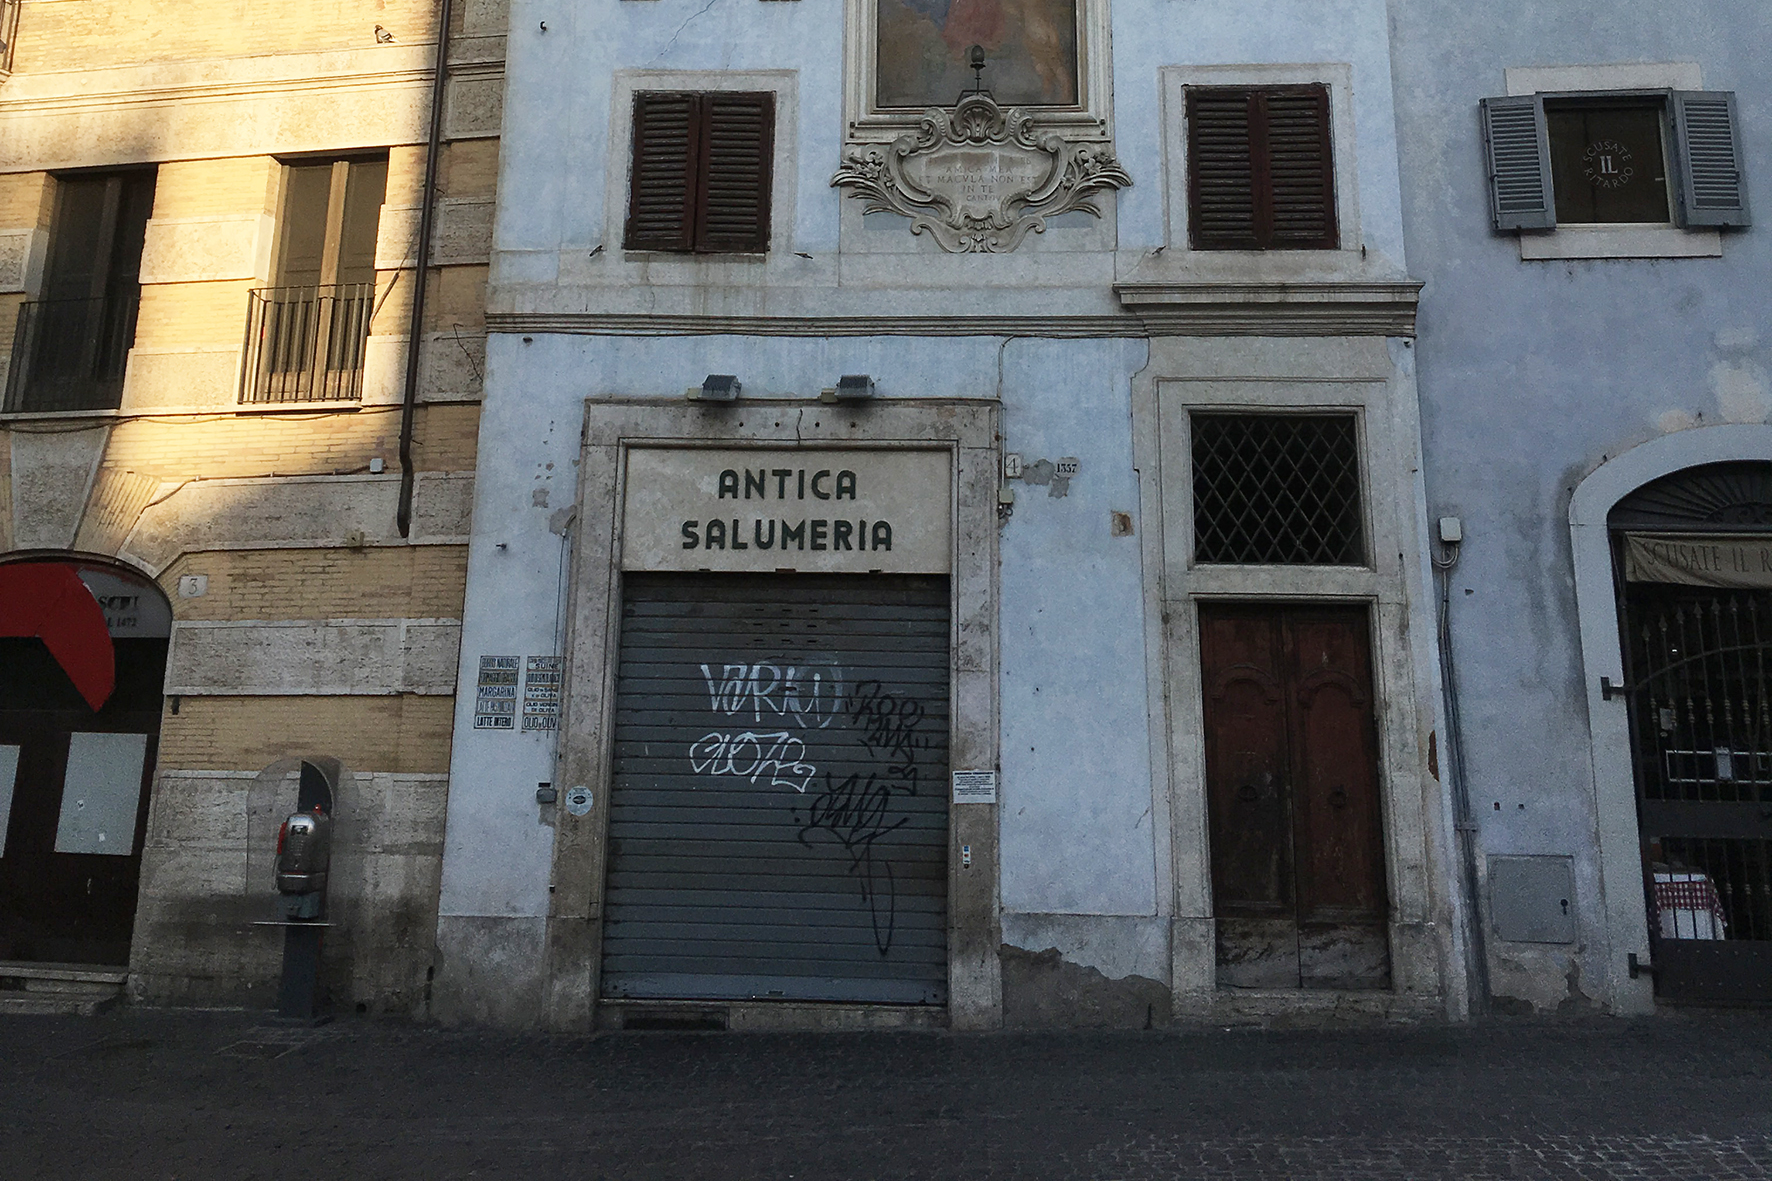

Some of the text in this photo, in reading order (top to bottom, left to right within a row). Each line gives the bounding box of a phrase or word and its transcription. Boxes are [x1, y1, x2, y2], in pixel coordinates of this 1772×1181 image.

[1583, 141, 1632, 162] SCUSATE
[1600, 156, 1618, 173] IL
[938, 175, 984, 184] MACVLA
[1584, 167, 1633, 188] RITARDO
[963, 185, 994, 193] IN TE
[1006, 458, 1018, 474] 4
[718, 469, 856, 500] ANTICA
[681, 519, 892, 551] SALUMERIA
[1643, 541, 1722, 572] SCUSATE
[1732, 547, 1750, 572] IL
[188, 578, 198, 595] 3
[478, 686, 515, 698] MARGARINA
[477, 716, 493, 727] LATTE
